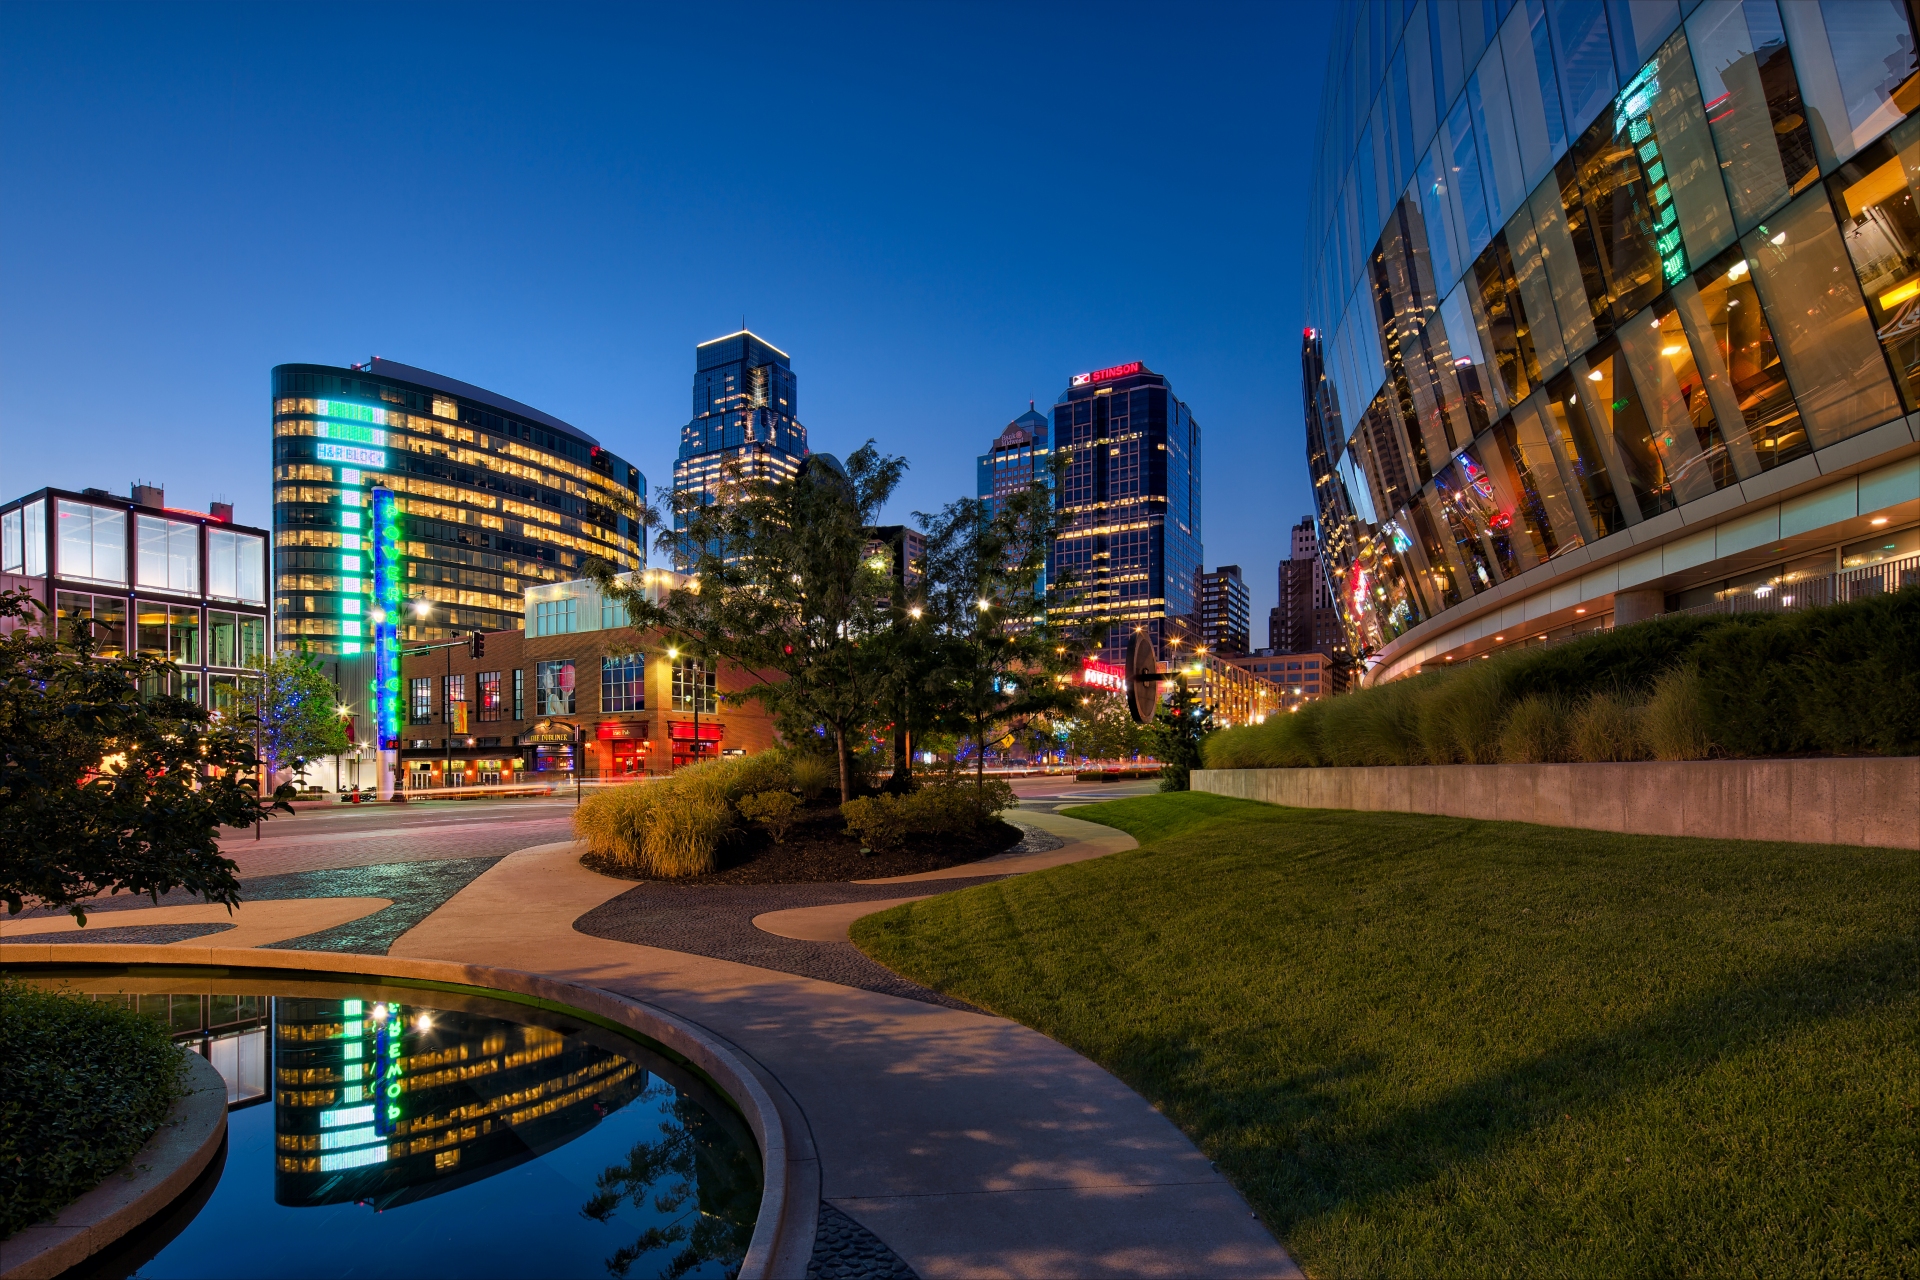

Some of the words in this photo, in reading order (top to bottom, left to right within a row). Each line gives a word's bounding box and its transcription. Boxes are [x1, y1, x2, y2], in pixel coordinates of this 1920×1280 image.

[1093, 362, 1138, 381] STINSON
[318, 444, 342, 458] H&R
[346, 448, 384, 465] BLOCK
[384, 504, 400, 602] POWER
[1084, 668, 1114, 688] POWER
[541, 733, 568, 741] DUBLINER
